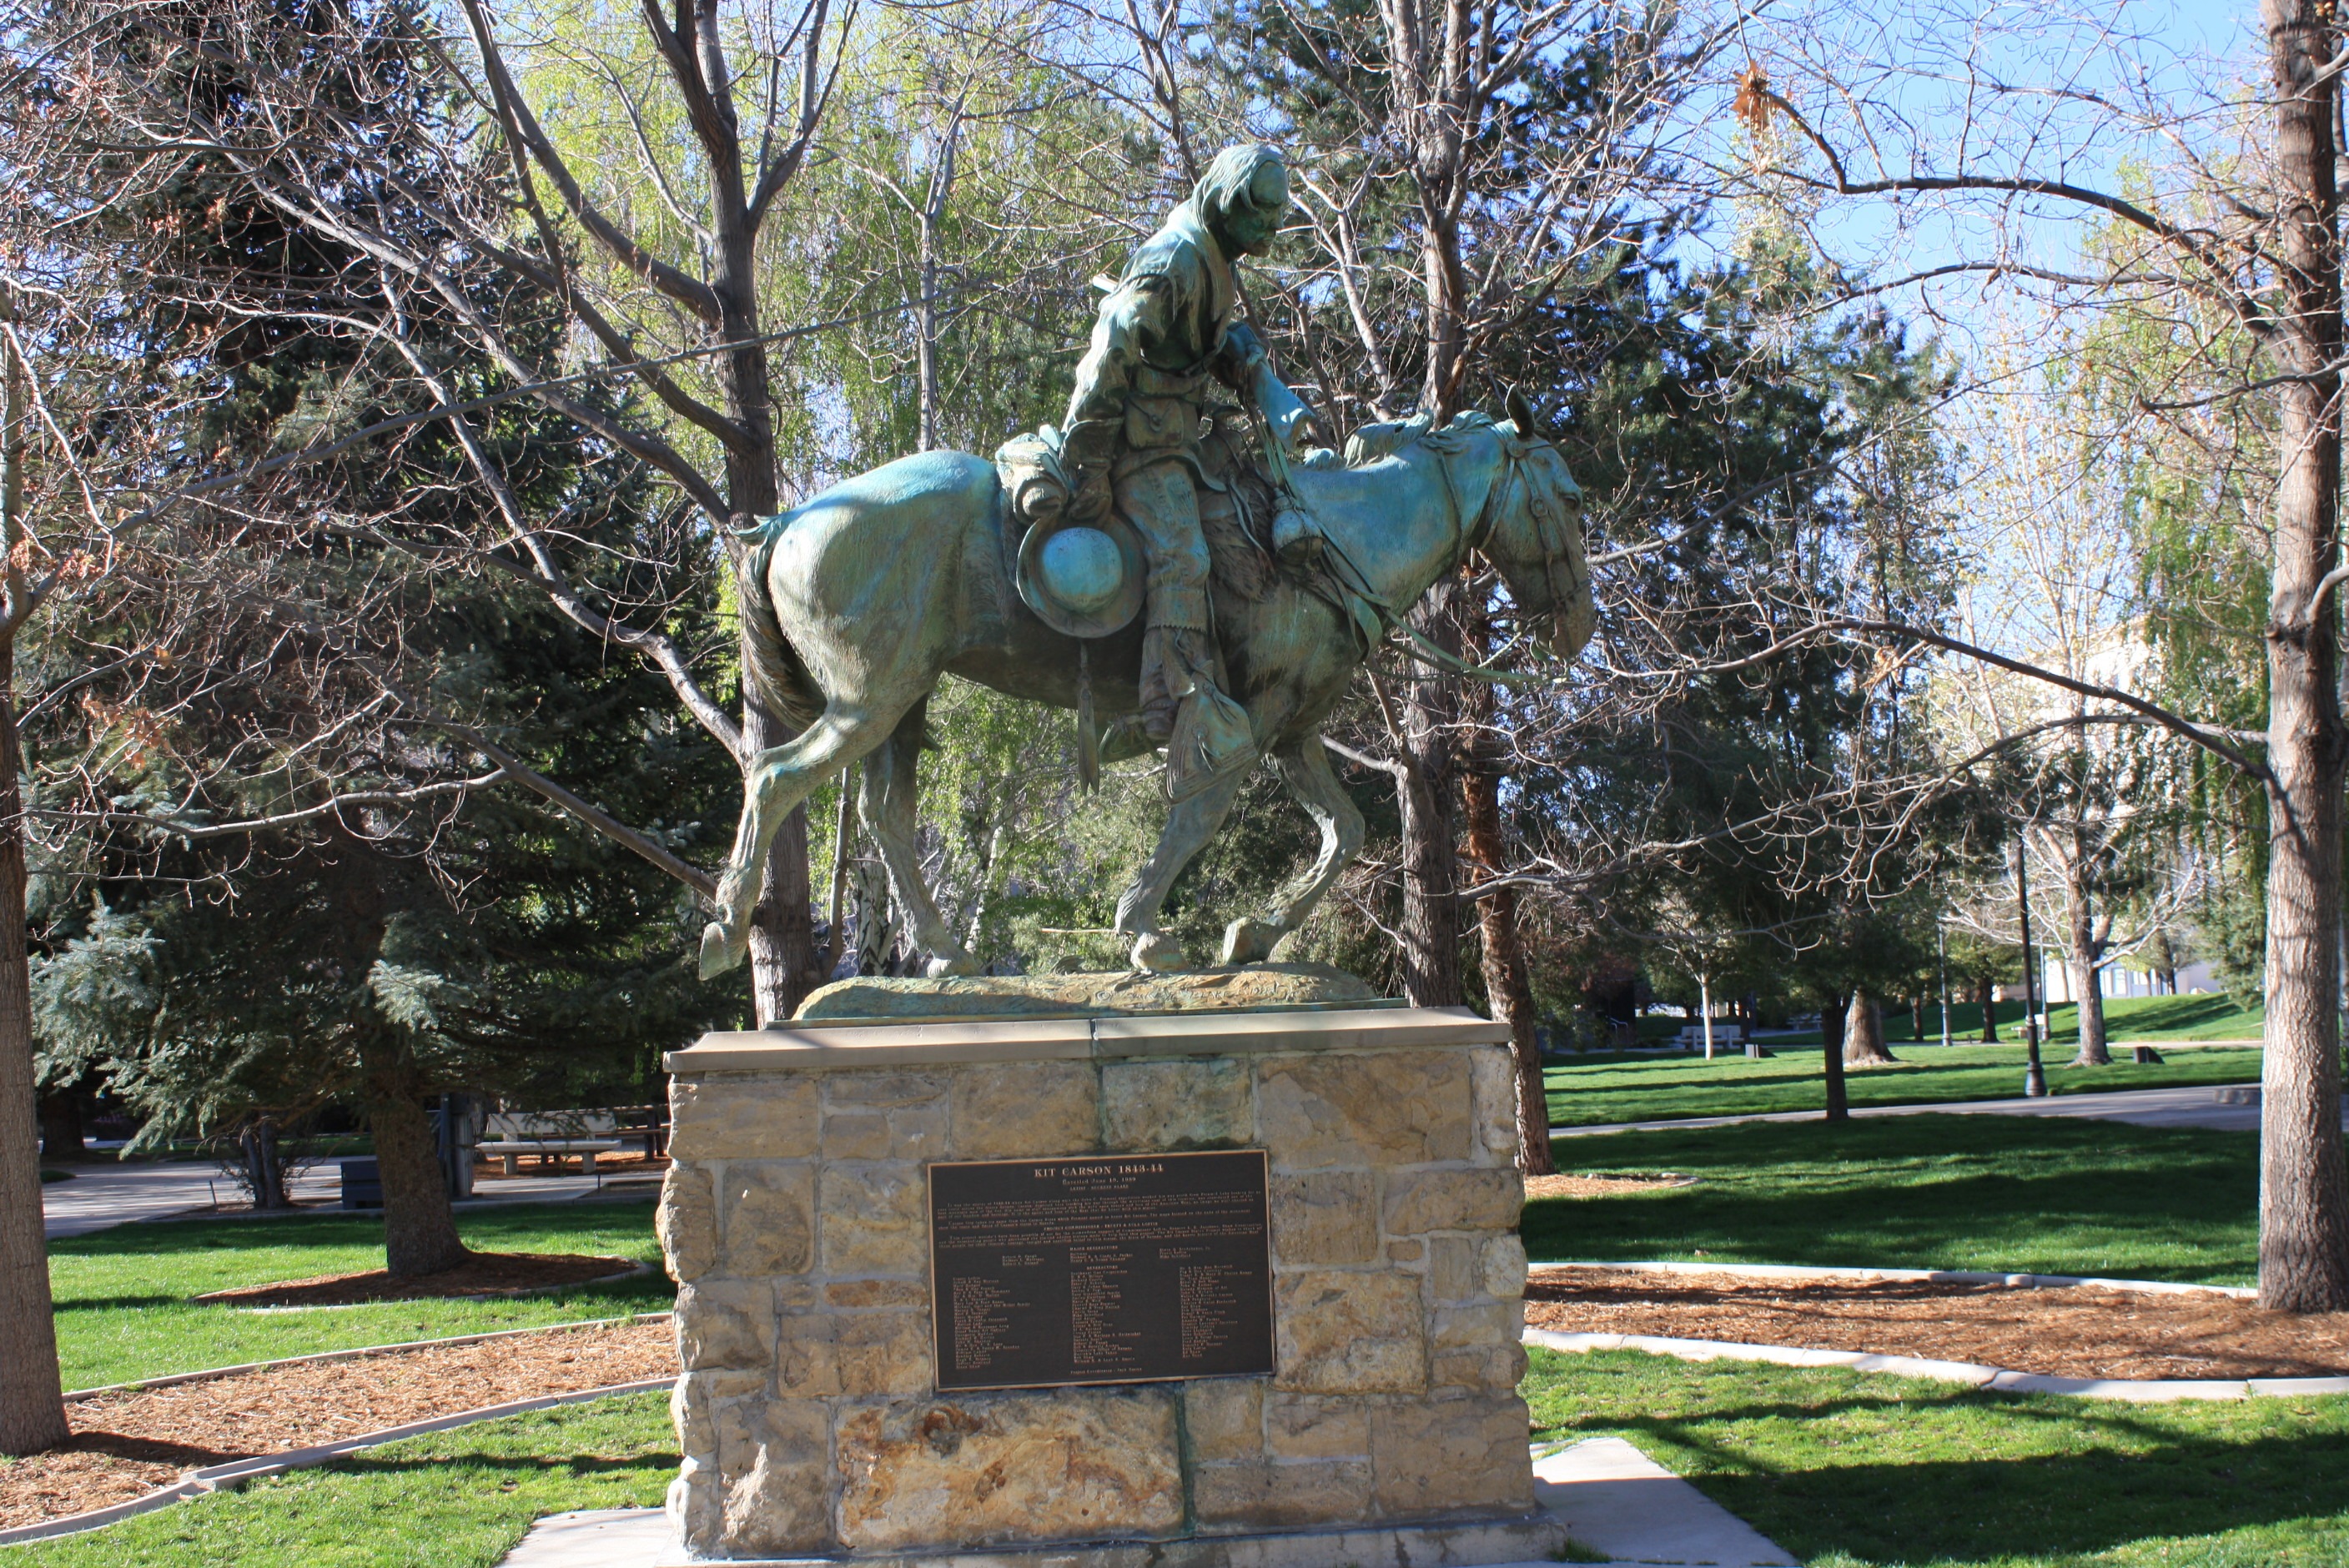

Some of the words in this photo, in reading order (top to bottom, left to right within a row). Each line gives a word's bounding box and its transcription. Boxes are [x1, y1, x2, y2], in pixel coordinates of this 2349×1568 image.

[1034, 1168, 1056, 1178] KIT
[1061, 1165, 1112, 1176] CARSON
[1119, 1163, 1164, 1174] 1843-44
